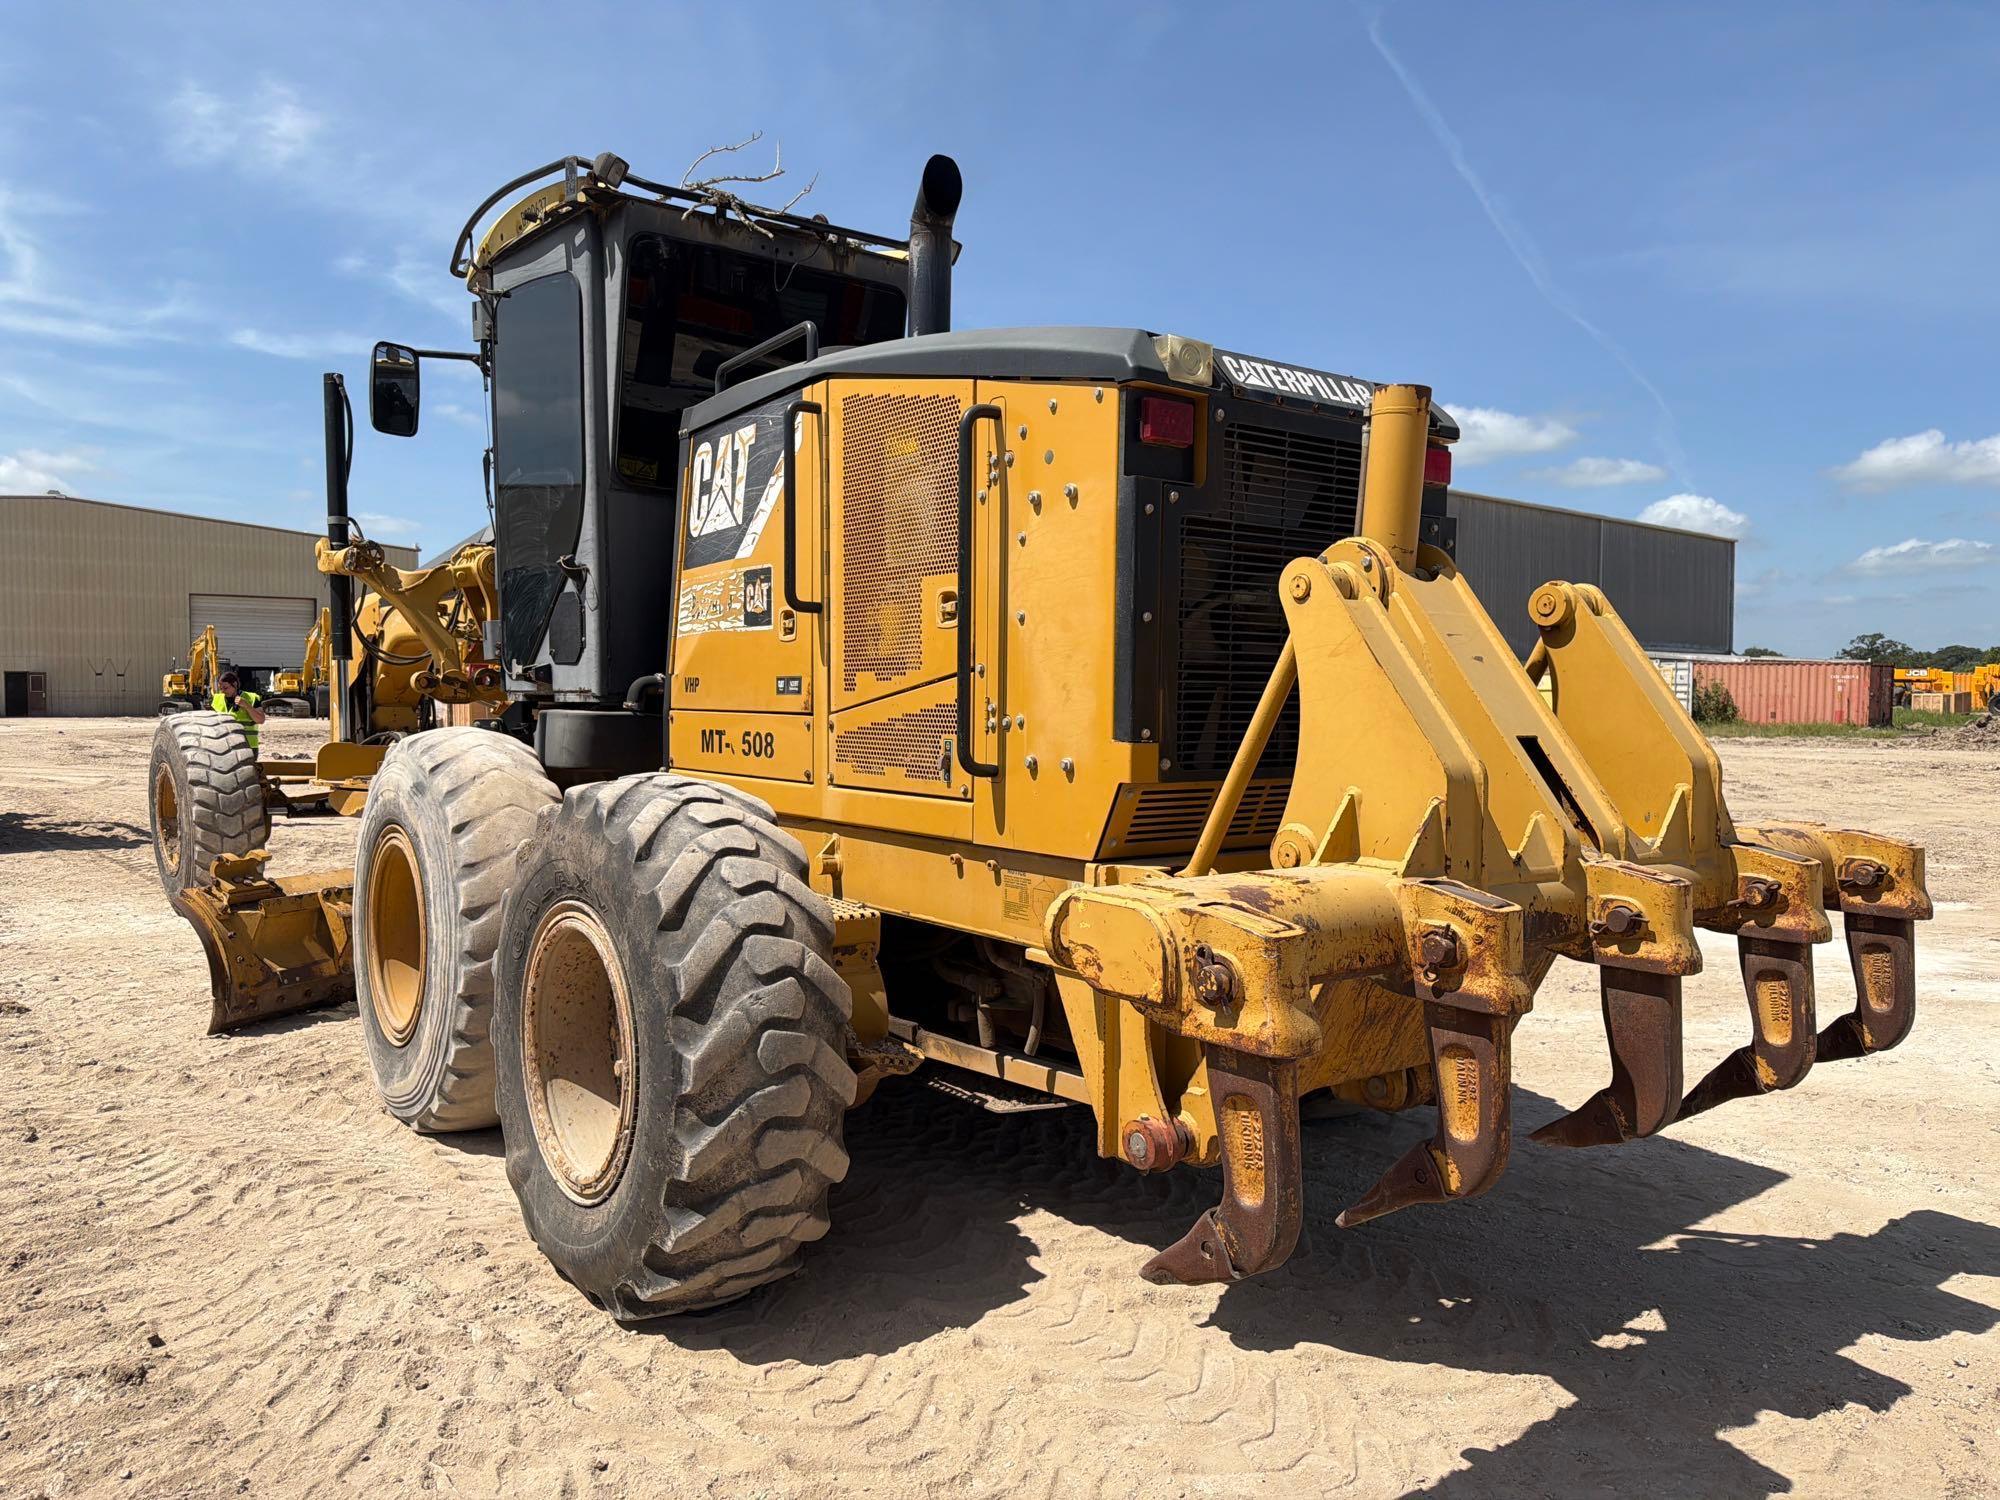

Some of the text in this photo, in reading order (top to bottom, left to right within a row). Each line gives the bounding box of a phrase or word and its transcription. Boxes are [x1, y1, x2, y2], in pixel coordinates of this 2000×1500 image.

[1222, 355, 1373, 407] CATERPILLAR
[689, 423, 757, 538] CAT
[746, 577, 771, 614] CAT
[684, 676, 700, 693] VHP
[1905, 669, 1928, 677] JCB
[741, 730, 775, 758] 508
